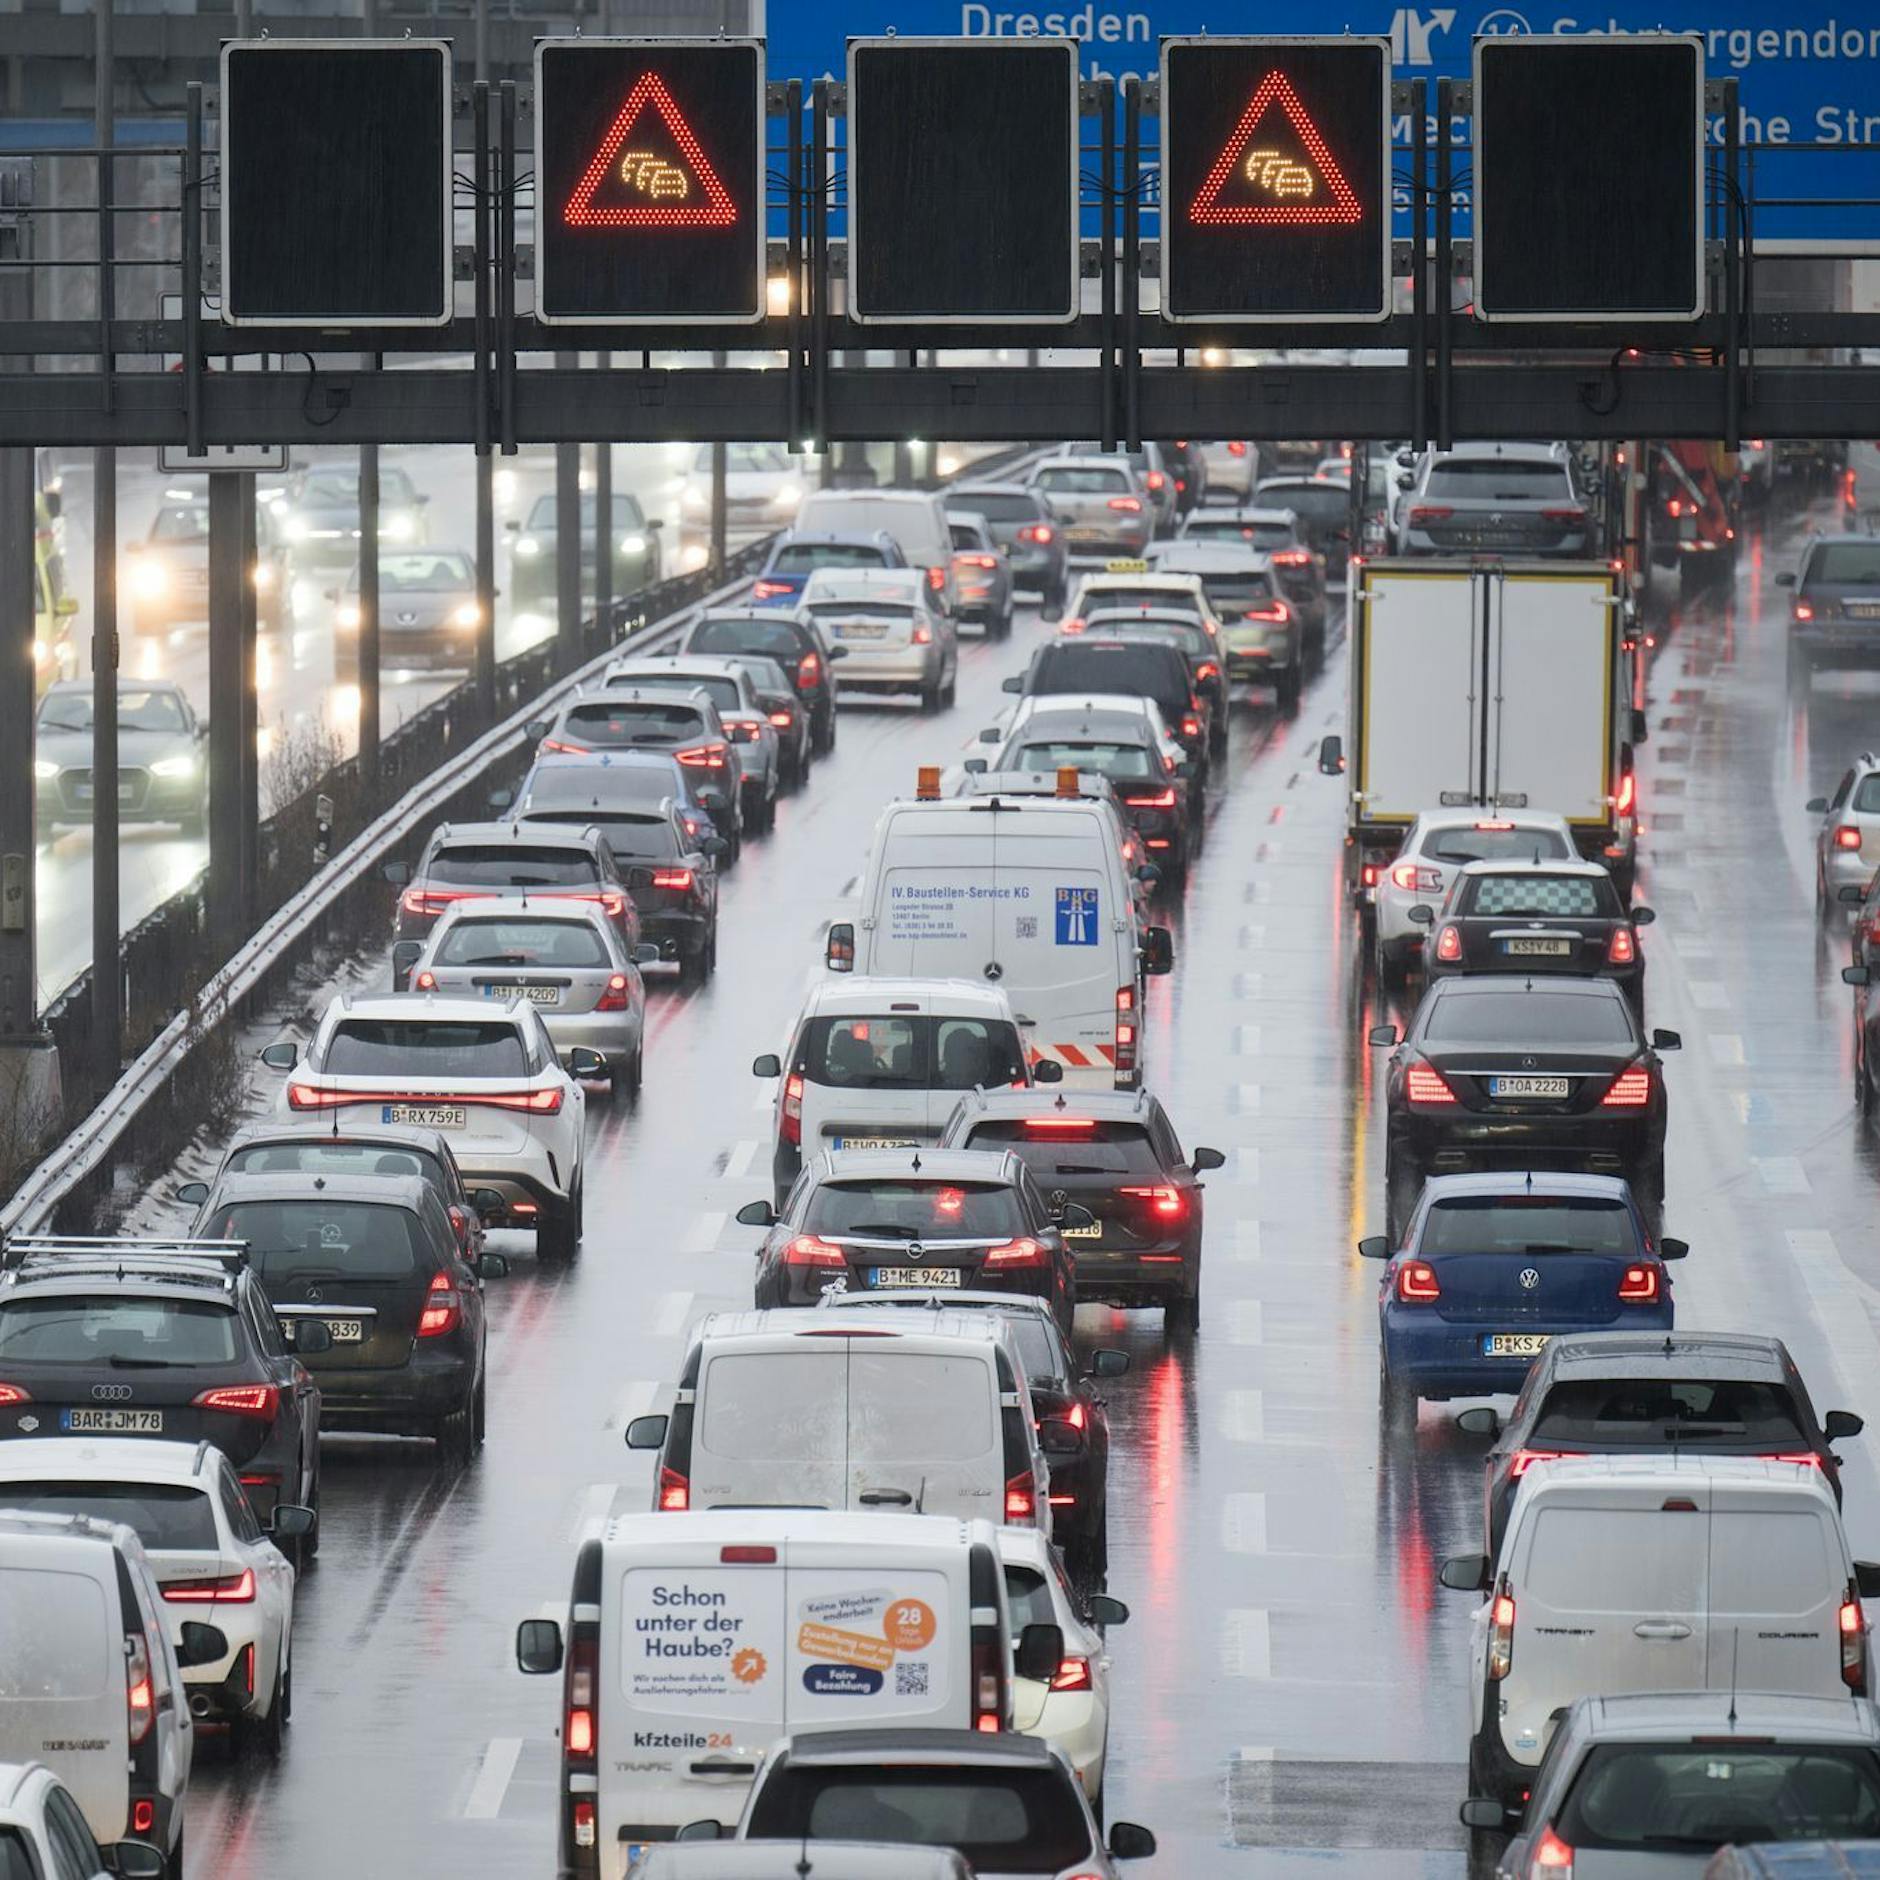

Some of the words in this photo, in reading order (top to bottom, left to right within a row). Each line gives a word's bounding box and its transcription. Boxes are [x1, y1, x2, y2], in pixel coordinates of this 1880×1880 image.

[962, 4, 1150, 42] Dresden
[907, 887, 1010, 898] Baustellen-Service
[1014, 887, 1030, 898] KG
[526, 989, 556, 1000] 4209
[1499, 1080, 1507, 1092] B
[1535, 1080, 1566, 1092] 2228
[392, 1110, 400, 1123] B
[408, 1110, 426, 1123] RX
[429, 1110, 463, 1124] 759E
[879, 1270, 889, 1283] B
[901, 1270, 918, 1283] ME
[922, 1270, 958, 1284] 9421
[1494, 1337, 1503, 1350] B
[1513, 1337, 1533, 1350] KS
[71, 1411, 102, 1427] BAR
[115, 1412, 137, 1428] JM
[140, 1413, 160, 1429] 78
[652, 1584, 726, 1606] Schon
[807, 1601, 837, 1613] Keine
[636, 1614, 697, 1631] unter
[703, 1610, 744, 1631] der
[897, 1607, 922, 1625] 28
[1534, 1627, 1596, 1635] TRANSIT
[646, 1636, 734, 1657] Haube?
[633, 1674, 650, 1682] Wir
[652, 1673, 686, 1682] suchen
[688, 1673, 709, 1682] dich
[710, 1673, 725, 1682] als
[830, 1669, 858, 1680] Faire
[633, 1685, 728, 1696] Auslieferungsfahrer
[814, 1680, 872, 1693] Bezahlung
[633, 1732, 734, 1748] kfzteile24
